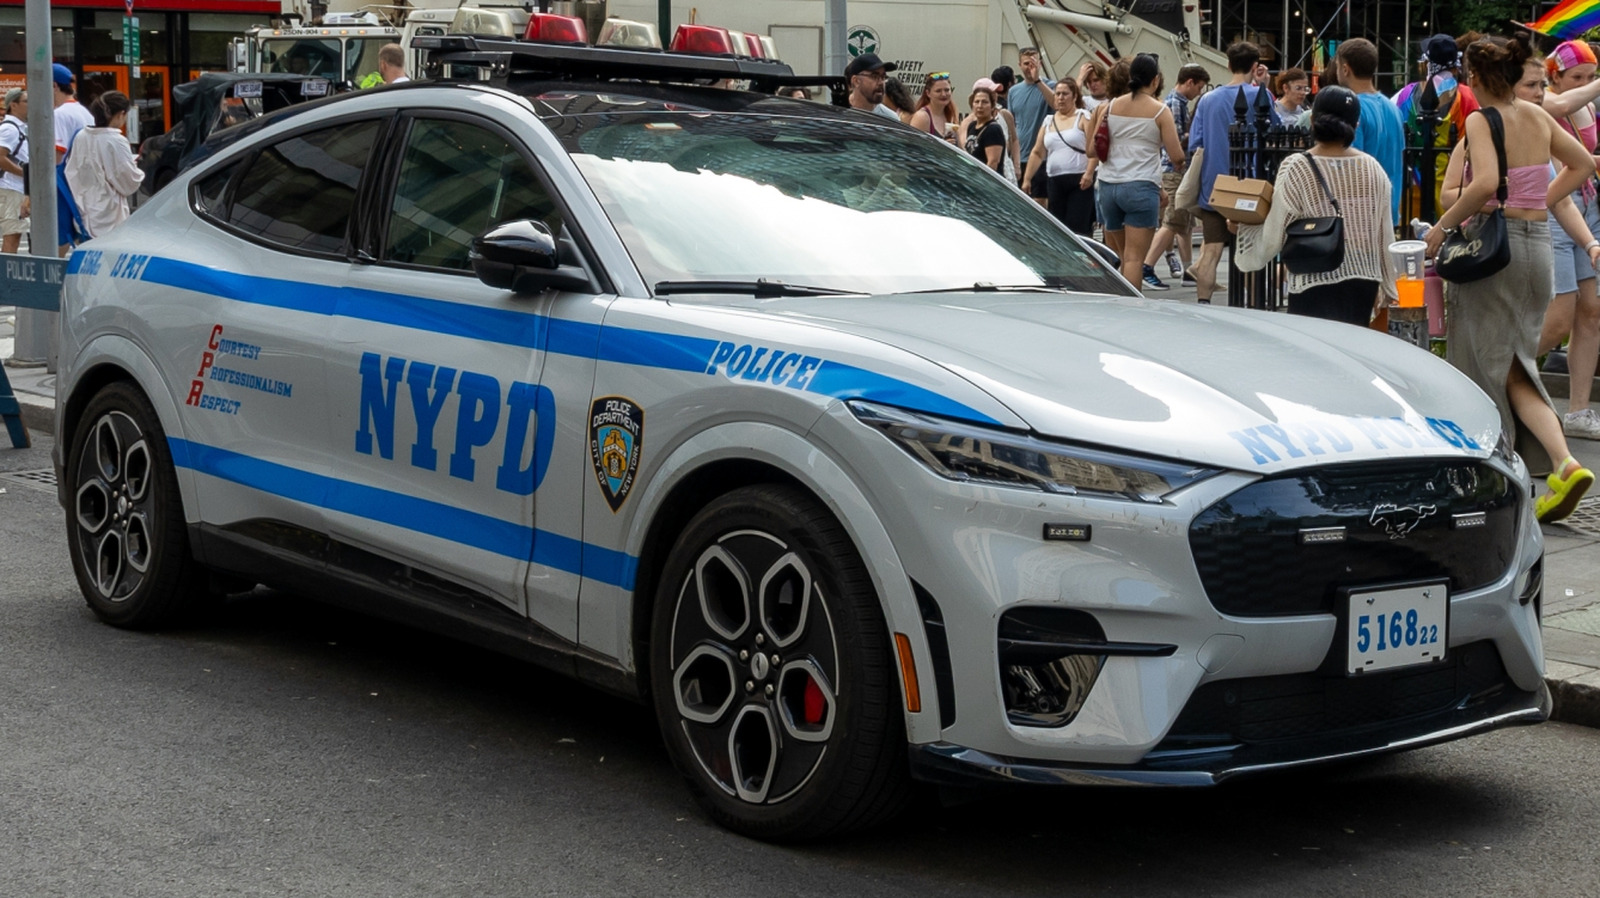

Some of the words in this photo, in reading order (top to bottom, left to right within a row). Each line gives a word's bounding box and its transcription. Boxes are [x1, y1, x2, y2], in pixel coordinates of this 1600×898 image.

[895, 60, 924, 72] SAFETY
[6, 261, 36, 281] POLICE
[42, 263, 63, 284] LINE
[208, 324, 262, 360] COURTESY
[197, 352, 293, 398] PROFESSIONALISM
[706, 341, 822, 390] POLICE
[186, 380, 241, 415] RESPECT
[604, 400, 632, 416] POLICE
[355, 351, 556, 496] NYPD
[592, 412, 640, 436] DEPARTMENT
[1228, 420, 1354, 465] NYPD
[591, 440, 601, 468] CITY
[598, 471, 607, 485] OF
[621, 474, 633, 496] NEW
[629, 445, 640, 470] YORK
[1357, 608, 1418, 653] 5168
